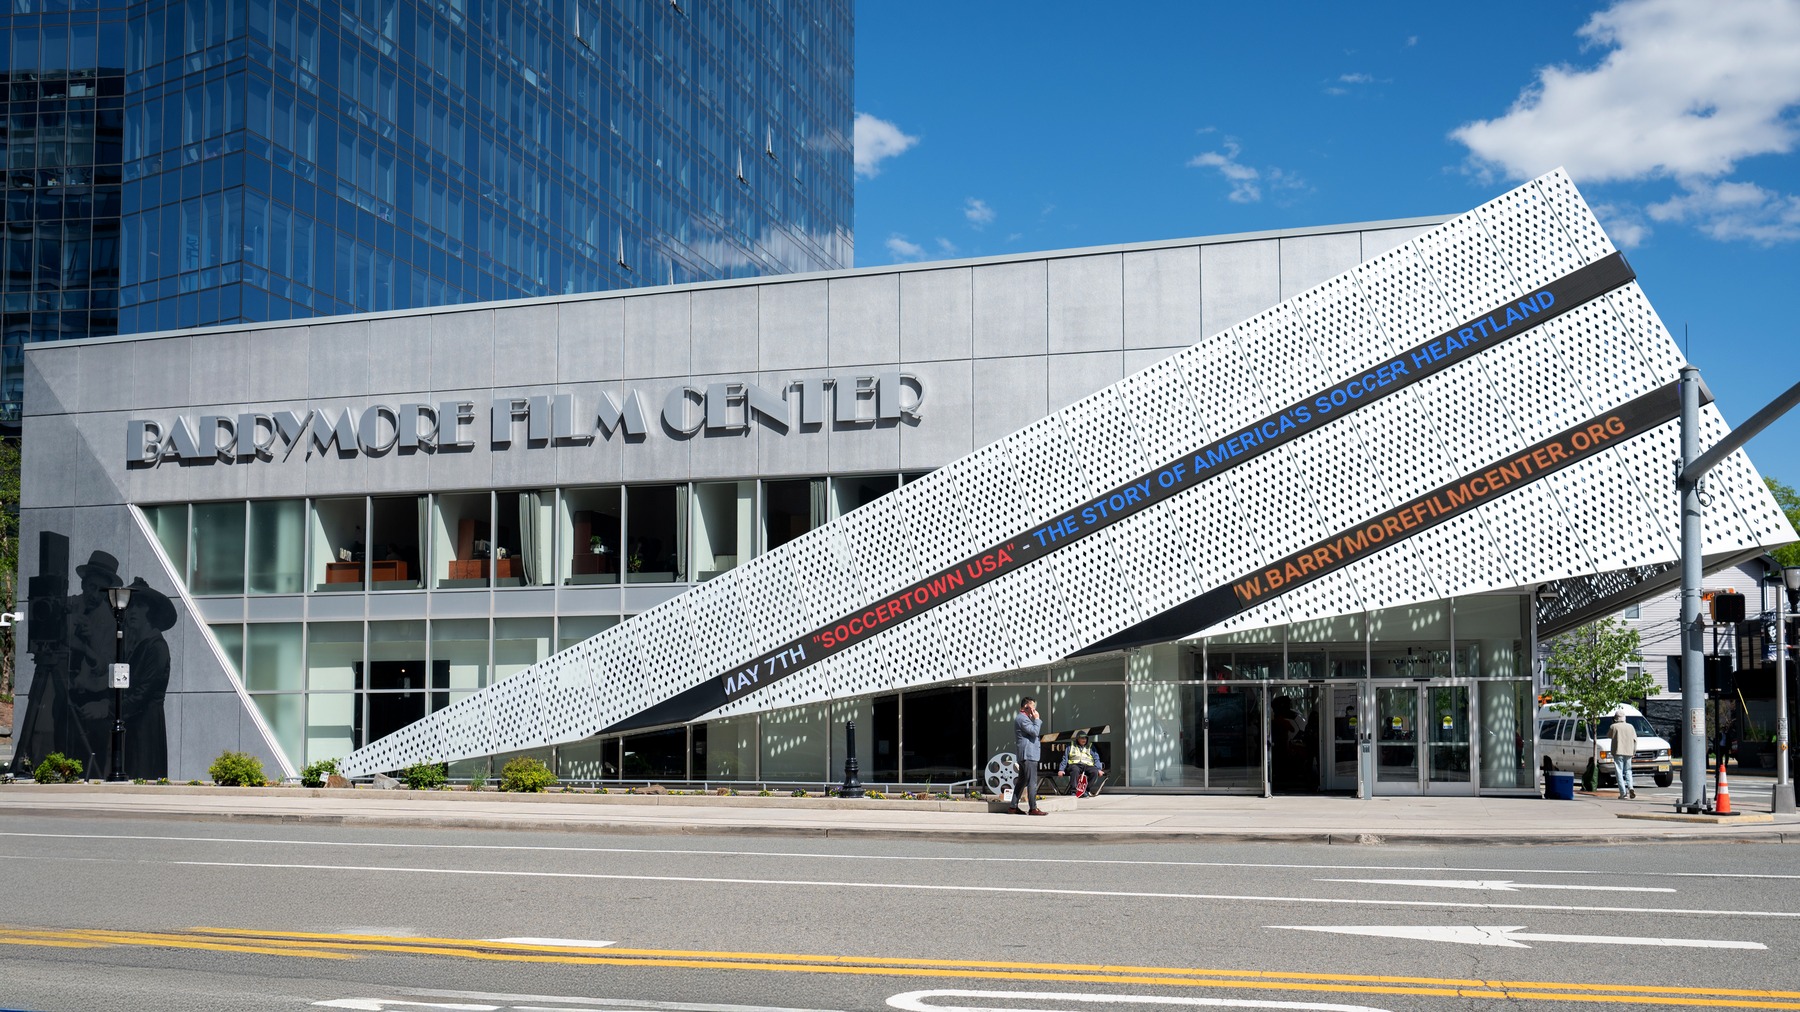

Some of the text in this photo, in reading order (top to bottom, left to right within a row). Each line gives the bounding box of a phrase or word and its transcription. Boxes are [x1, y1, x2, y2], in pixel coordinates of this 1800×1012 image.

[127, 371, 924, 464] BARRYMORE FILM CENTER
[724, 664, 760, 696] MAY
[764, 643, 807, 676] 7TH
[813, 569, 965, 650] "SOCCERTOWN
[968, 543, 1015, 579] USA"
[1033, 514, 1080, 547] THE
[1081, 478, 1151, 526] STORY
[1157, 462, 1186, 489] OF
[1194, 405, 1312, 475] AMERICA'S
[1315, 359, 1410, 414] SOCCER
[1410, 290, 1556, 370] HEARTLAND
[1233, 416, 1627, 602] W.BARRYMOREFILMCENTER.ORG
